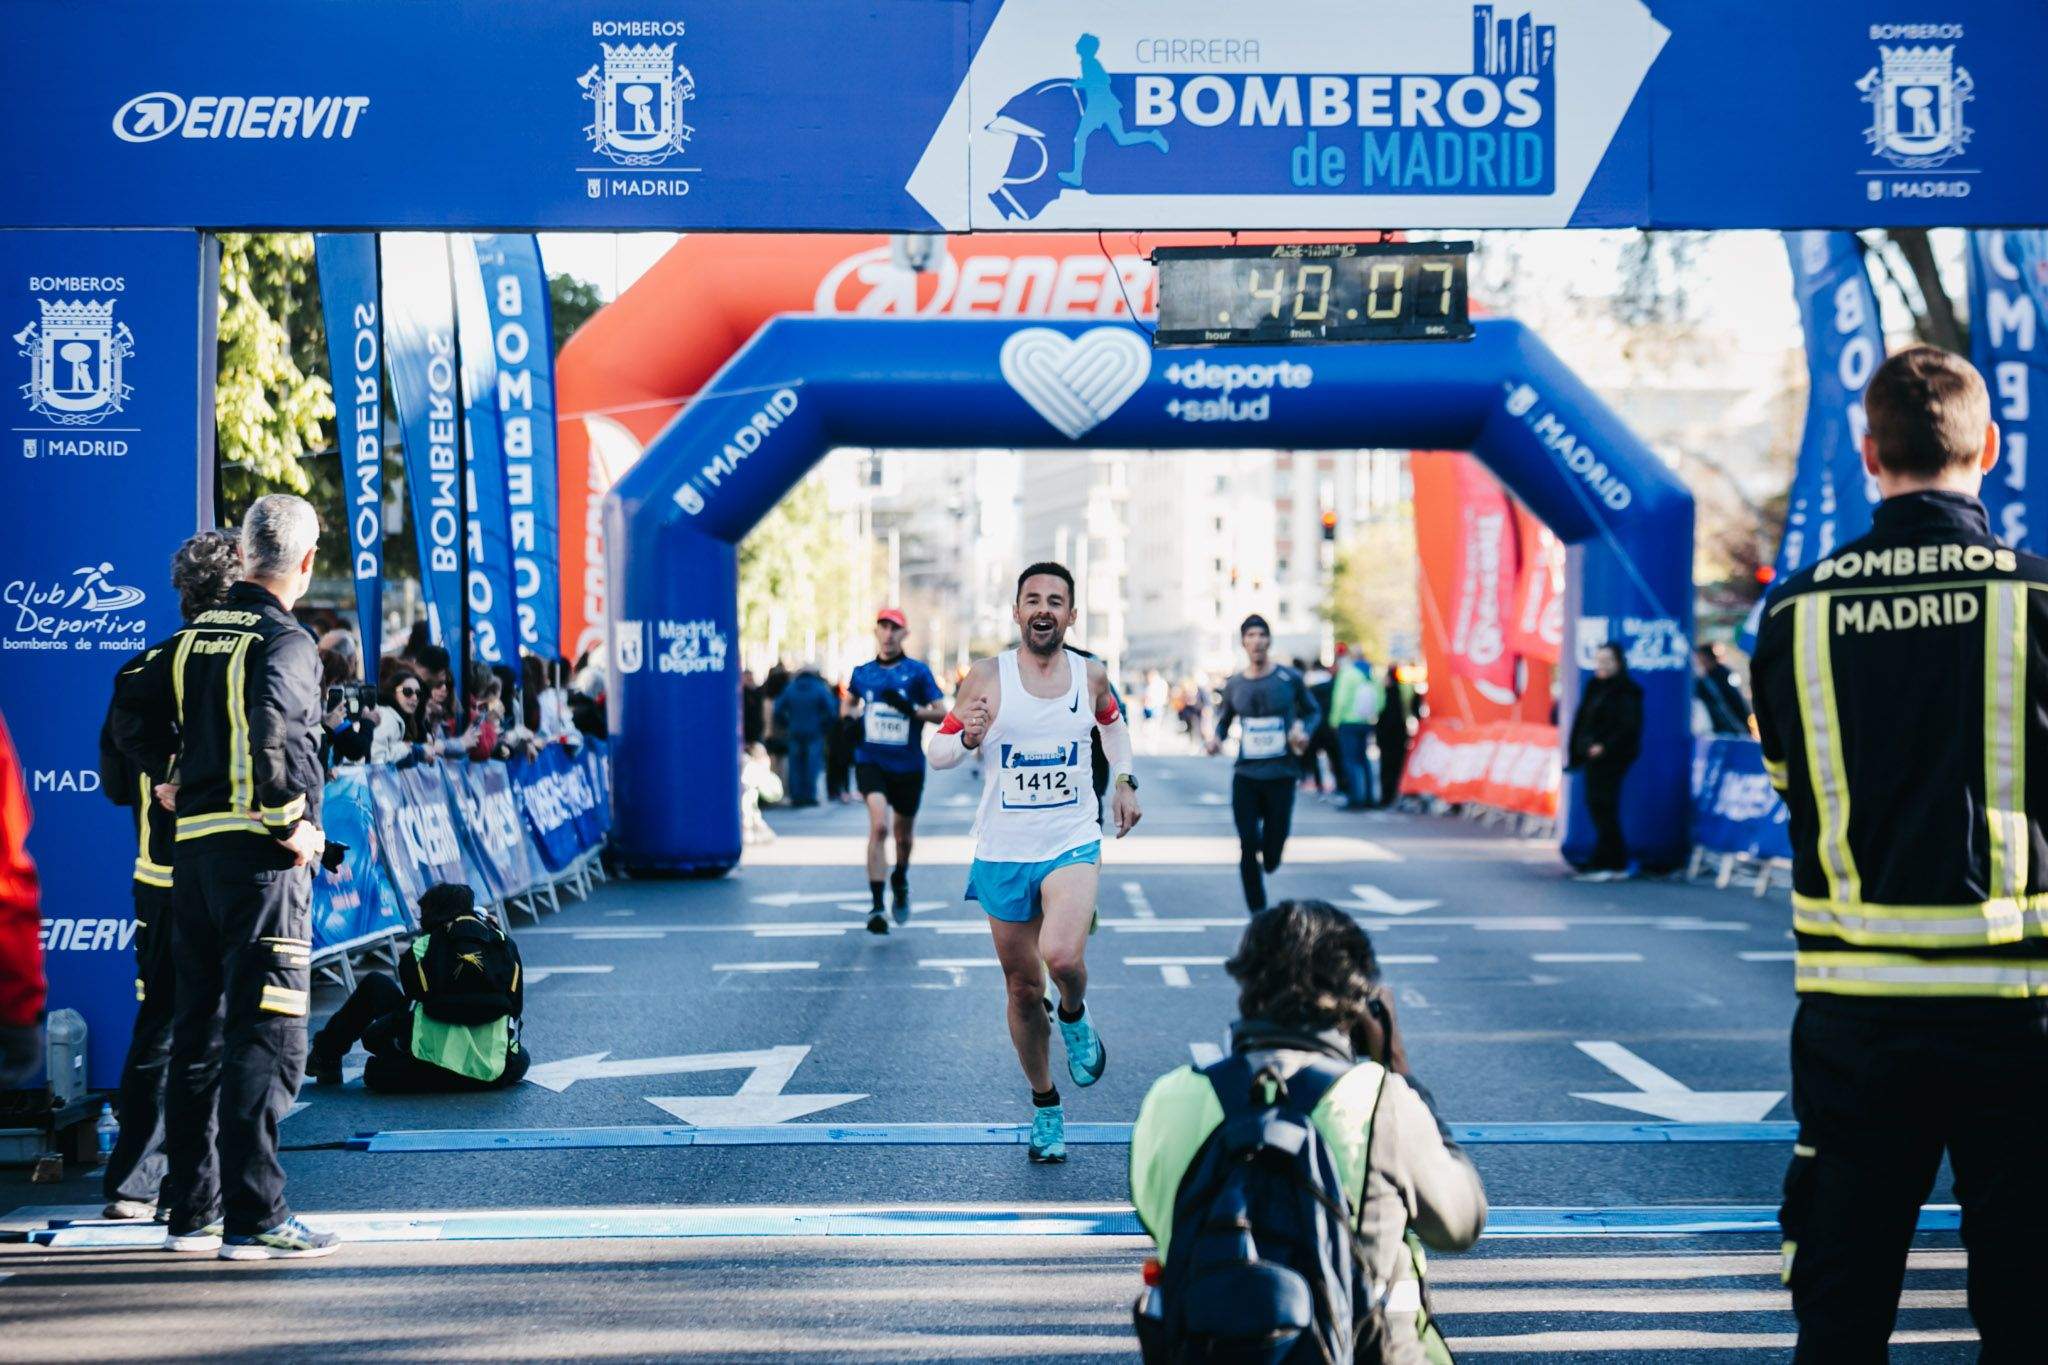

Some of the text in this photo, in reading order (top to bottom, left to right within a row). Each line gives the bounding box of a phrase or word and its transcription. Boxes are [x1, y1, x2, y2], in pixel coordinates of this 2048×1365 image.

[592, 22, 686, 37] BOMBEROS
[1869, 24, 1964, 40] BOMBEROS
[1135, 39, 1260, 64] CARRERA
[1134, 75, 1543, 128] BOMBEROS
[181, 95, 370, 140] ENERVIT
[1290, 131, 1544, 188] de MADRID
[611, 180, 690, 197] MADRID
[1891, 181, 1971, 199] MADRID
[30, 276, 126, 292] BOMBEROS
[955, 255, 1159, 318] ENER
[1204, 331, 1231, 340] hour
[1164, 360, 1313, 392] +deporte
[1164, 395, 1271, 422] +salud
[48, 440, 129, 457] MADRID
[701, 387, 799, 487] MADRID
[1534, 413, 1632, 511] MADRID
[1813, 543, 2018, 582] BOMBEROS
[4, 580, 66, 606] Club
[16, 603, 146, 640] Deportivo
[1835, 592, 1979, 636] MADRID
[3, 637, 146, 650] bomberos de madrid
[1015, 771, 1067, 791] 1412
[38, 918, 138, 951] ENERV
